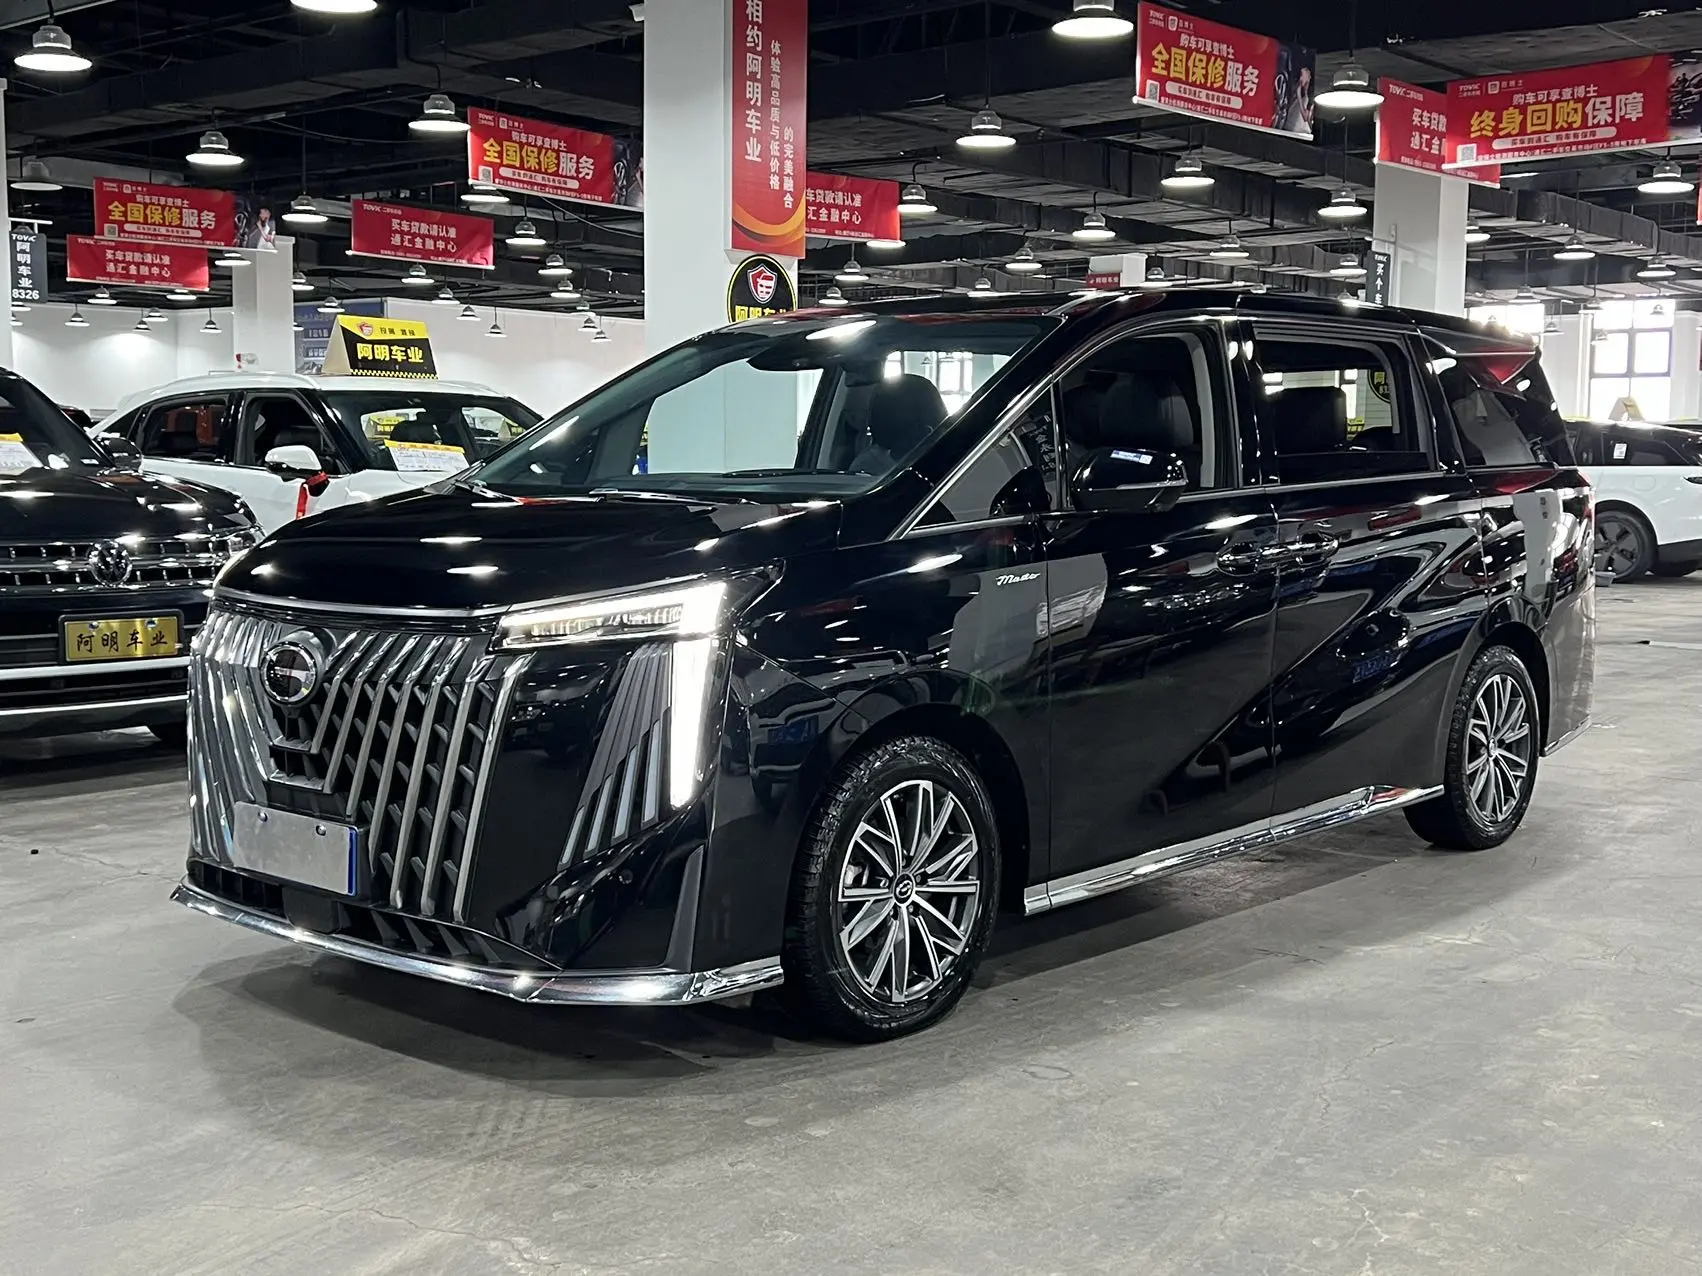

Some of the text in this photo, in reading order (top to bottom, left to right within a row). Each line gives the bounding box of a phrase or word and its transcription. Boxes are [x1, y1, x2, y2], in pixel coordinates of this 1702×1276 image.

[1179, 33, 1235, 59] 购车可享查博士
[745, 0, 762, 162] 相约阿明车业
[1152, 42, 1260, 97] 全国保修服务
[1512, 84, 1598, 106] 购车可享查博士
[769, 40, 781, 190] 体验高品质与低价格
[1412, 107, 1447, 133] 买车贷款
[1470, 91, 1644, 138] 终身回购保障
[511, 131, 567, 151] 购车可享查博士
[483, 137, 595, 180] 全国保修服务
[783, 126, 794, 209] 的完美融合
[108, 201, 216, 230] 全国保修服务
[807, 206, 861, 225] 汇金融中心
[391, 219, 457, 239] 买车贷款请认准
[391, 233, 457, 253] 通汇金融中心
[16, 241, 33, 288] 阿明车业
[105, 249, 171, 265] 买车贷款请认准
[106, 262, 171, 278] 通汇金融中心
[12, 288, 40, 300] 8326
[356, 342, 424, 363] 阿明车业
[77, 629, 168, 653] 阿明车业
